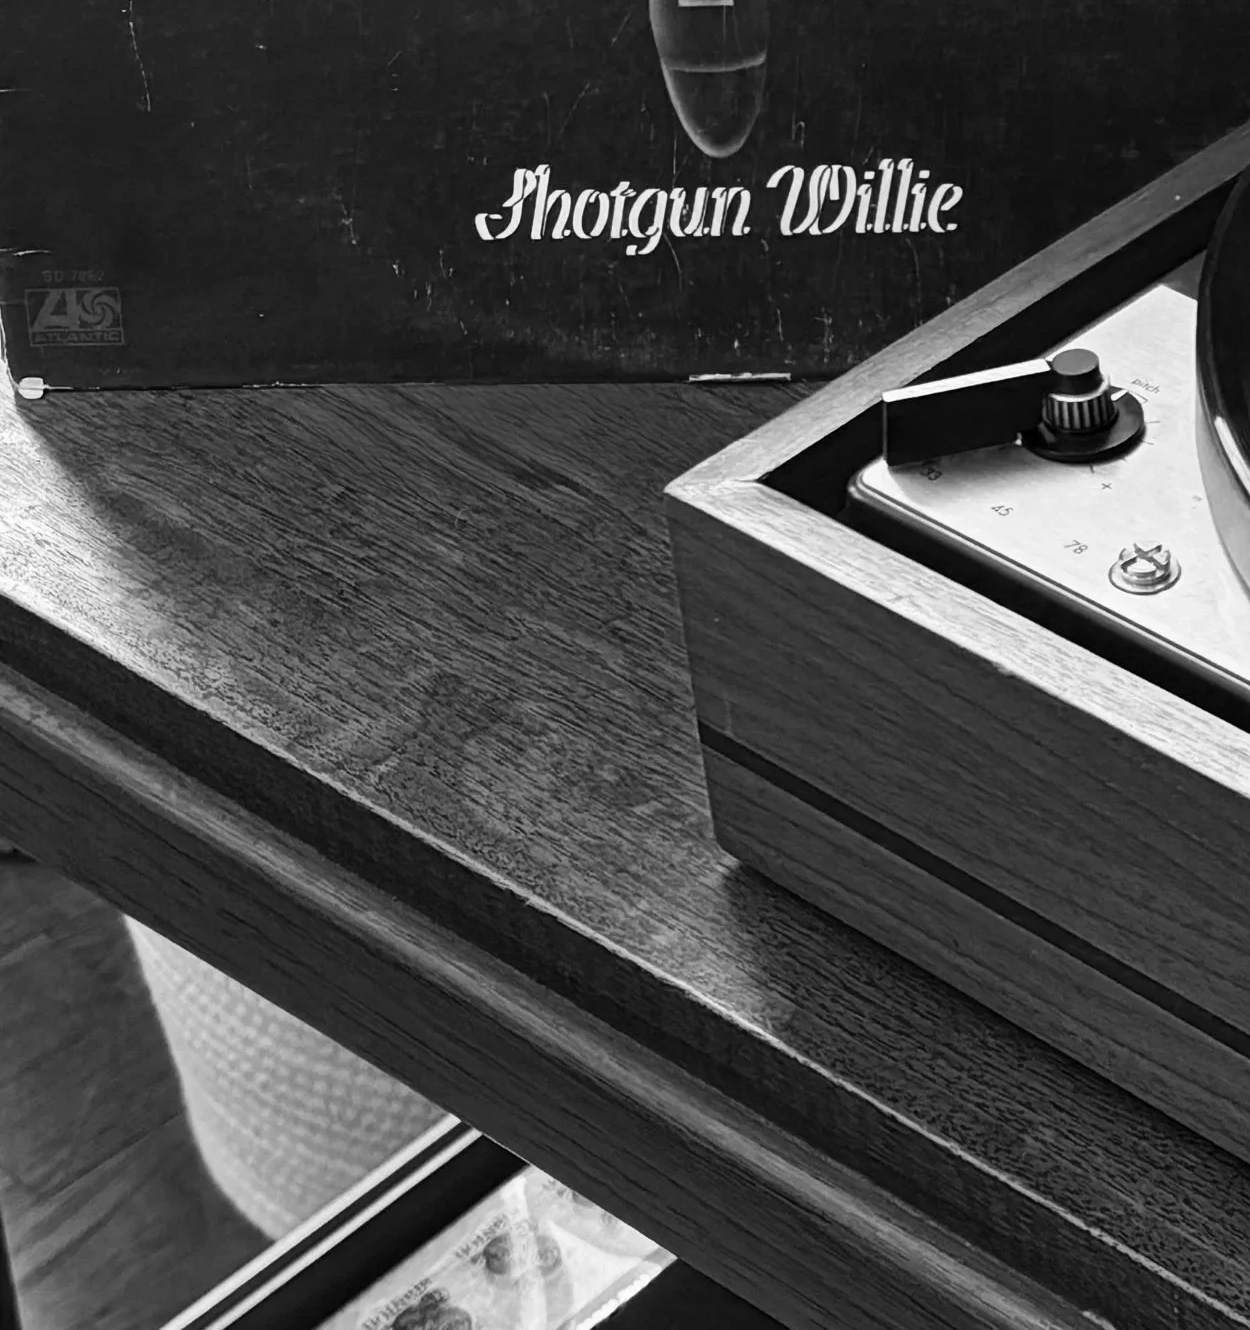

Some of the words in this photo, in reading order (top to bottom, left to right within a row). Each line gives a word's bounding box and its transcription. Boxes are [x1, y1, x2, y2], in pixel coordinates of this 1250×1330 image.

[474, 163, 752, 256] Shotgun
[766, 158, 964, 236] Willie
[1131, 378, 1161, 395] pitch
[990, 504, 1014, 517] 45
[1064, 540, 1089, 555] 78
